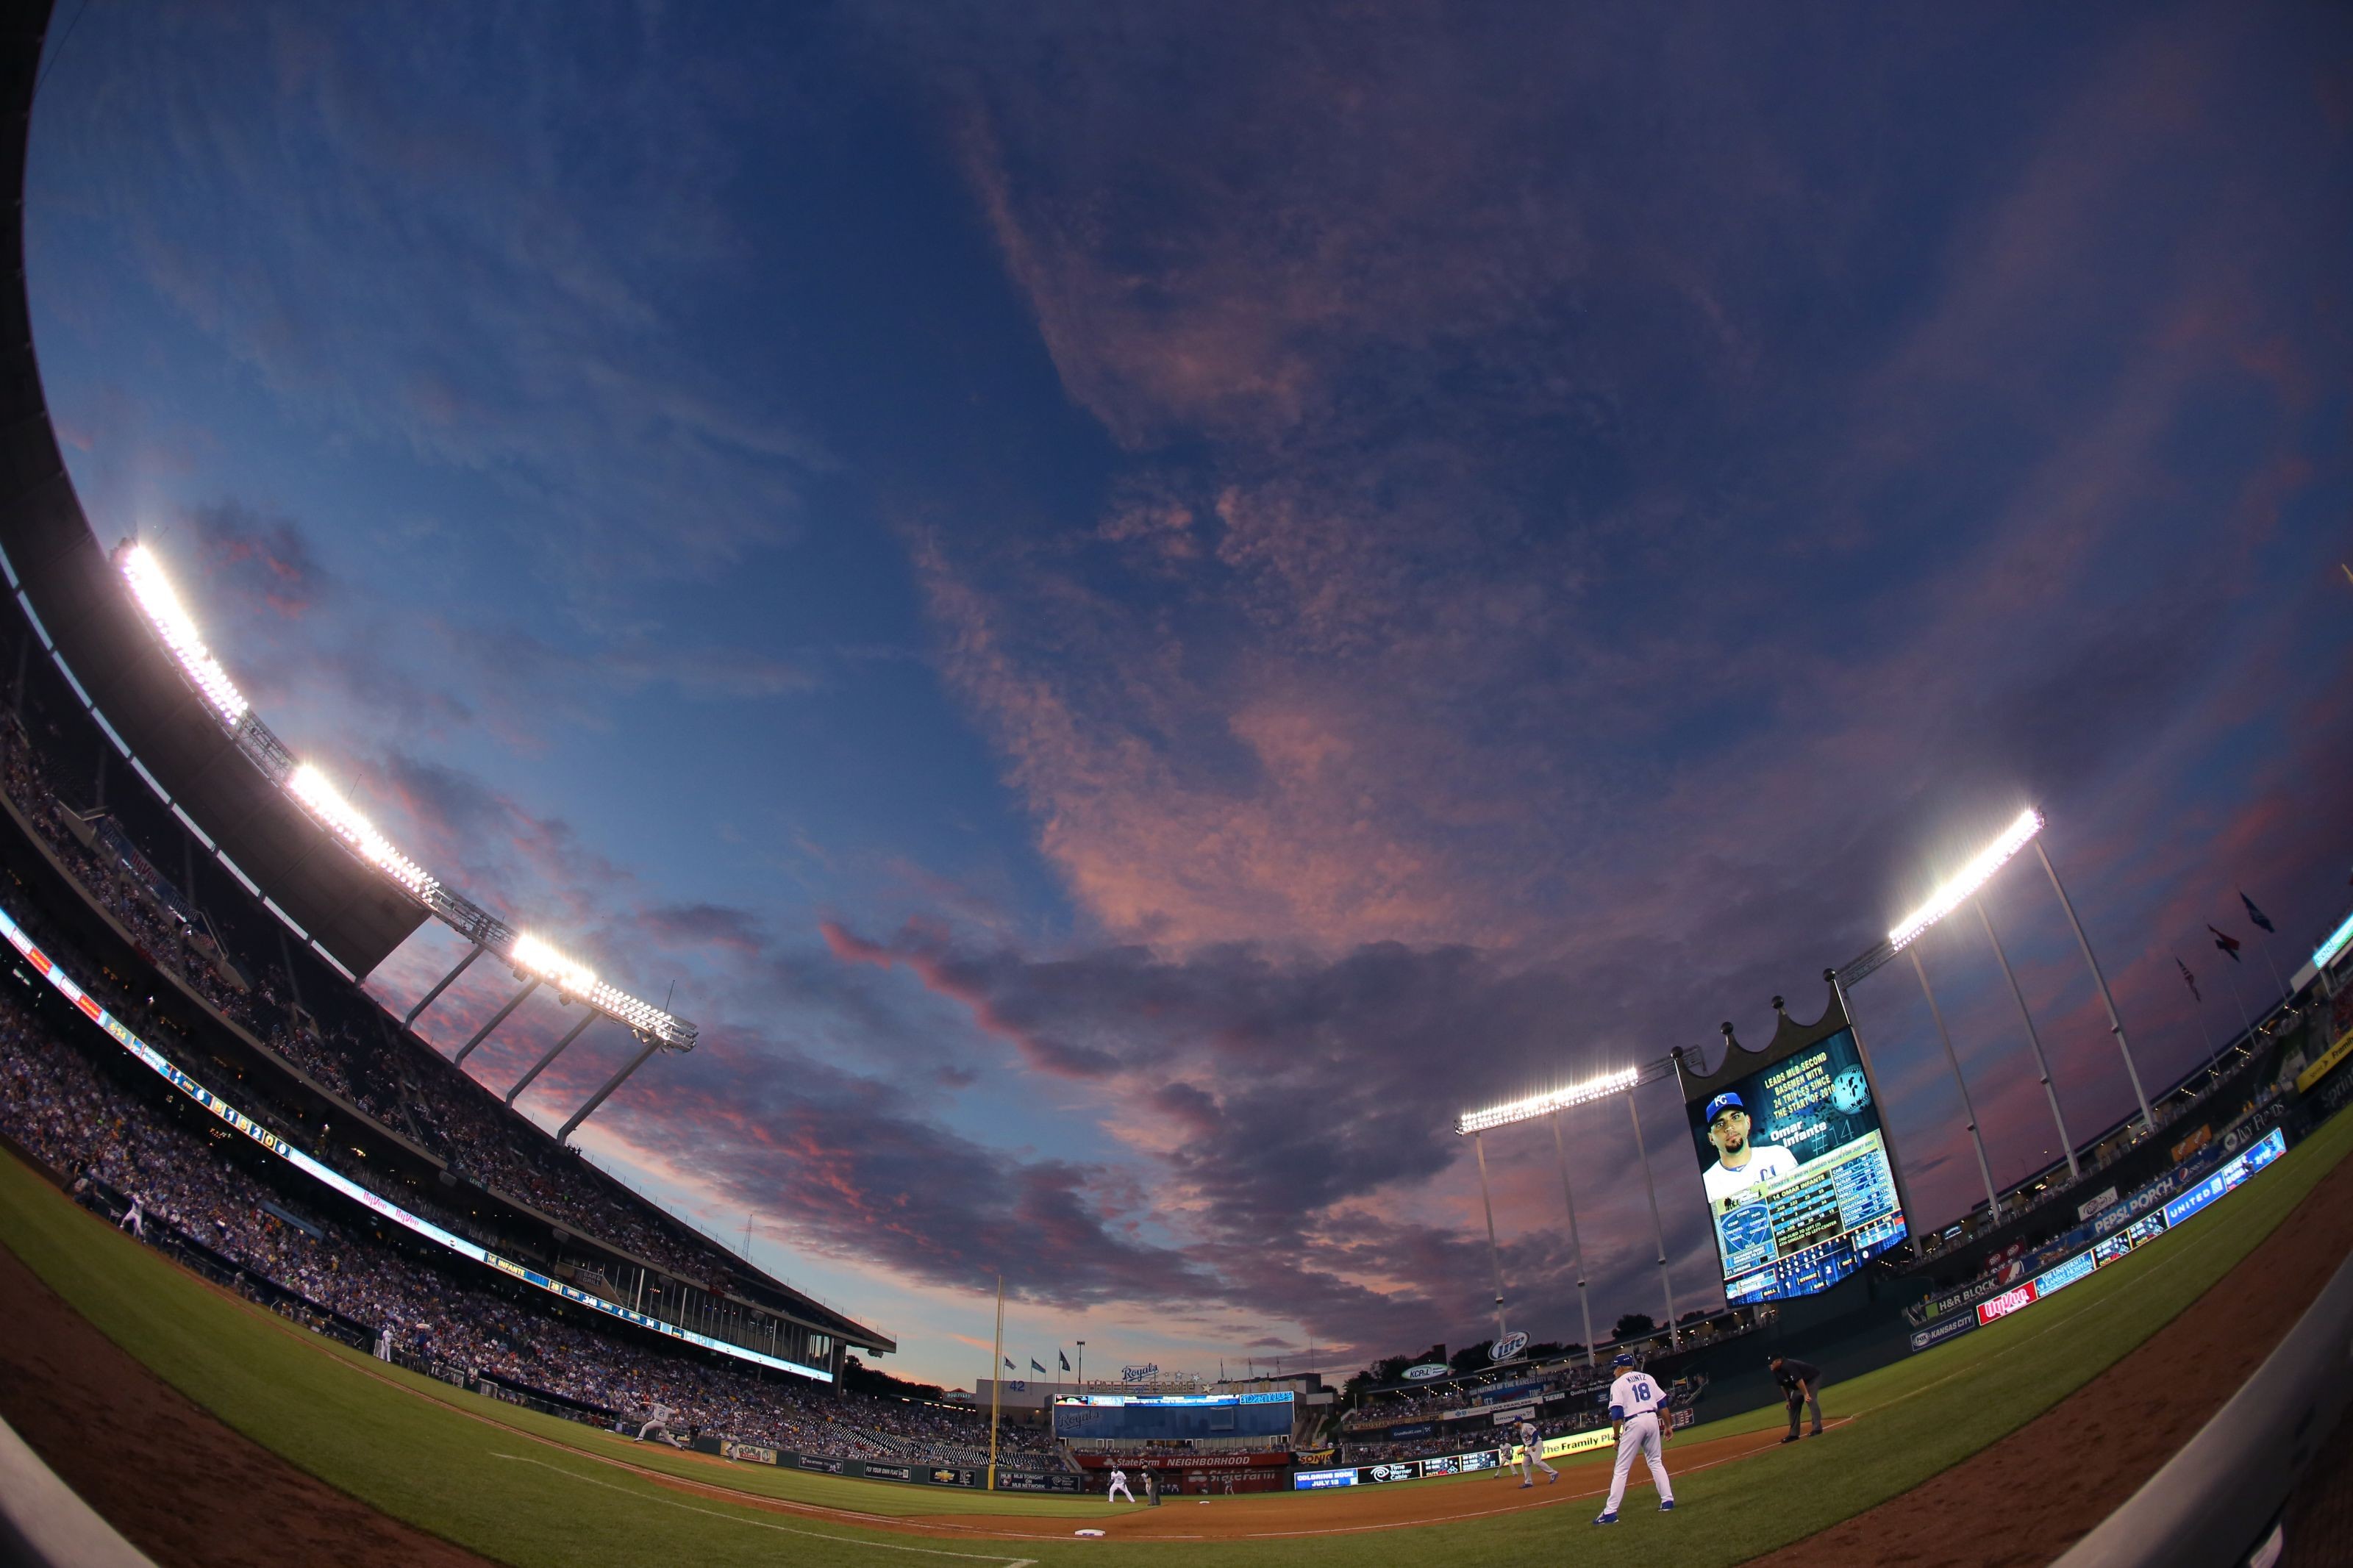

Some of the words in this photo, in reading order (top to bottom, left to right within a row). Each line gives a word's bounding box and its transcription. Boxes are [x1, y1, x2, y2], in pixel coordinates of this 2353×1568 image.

[109, 1023, 126, 1040] 8:54
[1765, 1073, 1785, 1089] LEADS
[1786, 1066, 1801, 1078] MLB
[1800, 1052, 1827, 1070] SECOND
[1774, 1075, 1805, 1096] BASEMEN
[1805, 1066, 1824, 1081] WITH
[196, 1089, 205, 1100] 6
[1774, 1097, 1782, 1109] 24
[1782, 1085, 1809, 1103] TRIPLES
[1810, 1074, 1831, 1090] SINCE
[1774, 1106, 1788, 1119] THE
[1790, 1098, 1809, 1114] START
[1810, 1092, 1818, 1103] OF
[1820, 1084, 1836, 1098] 2010
[228, 1111, 235, 1121] 1
[253, 1128, 261, 1139] 2
[1770, 1120, 1803, 1142] Omar
[1782, 1121, 1827, 1148] Infante
[1811, 1118, 1854, 1156] #14
[1781, 1185, 1799, 1197] OMAR
[1800, 1174, 1825, 1189] INFANTE
[363, 1191, 387, 1210] HyVee
[2094, 1206, 2129, 1234] PEPSI
[2129, 1177, 2174, 1212] PORCH
[2170, 1189, 2211, 1218] UNITED
[395, 1208, 419, 1226] HyVee
[1811, 1220, 1837, 1234] LEFT-CENTER
[498, 1260, 526, 1278] INFANTE
[1825, 1265, 1832, 1274] 2
[2053, 1255, 2085, 1275] UNIVERSITY
[1785, 1281, 1791, 1289] 1
[1939, 1295, 1960, 1311] H&R
[1963, 1281, 1995, 1300] BLOCK
[1985, 1289, 2029, 1317] HyVee
[1931, 1321, 1957, 1339] KANSAS
[1958, 1314, 1972, 1328] CITY
[1497, 1336, 1524, 1358] Lite
[1121, 1363, 1159, 1381] Royals
[1410, 1369, 1429, 1378] KCP&L
[1626, 1374, 1646, 1383] KUNTZ
[1010, 1381, 1025, 1392] 42
[1087, 1381, 1126, 1394] HALL
[1149, 1381, 1196, 1394] FAME
[1228, 1381, 1244, 1393] 20
[1258, 1381, 1271, 1392] 10
[1288, 1379, 1297, 1390] 5
[1632, 1382, 1651, 1403] 18
[1561, 1438, 1598, 1450] Framily
[1167, 1456, 1250, 1467] NEIGHBORHOOD
[1297, 1472, 1333, 1481] COLORING
